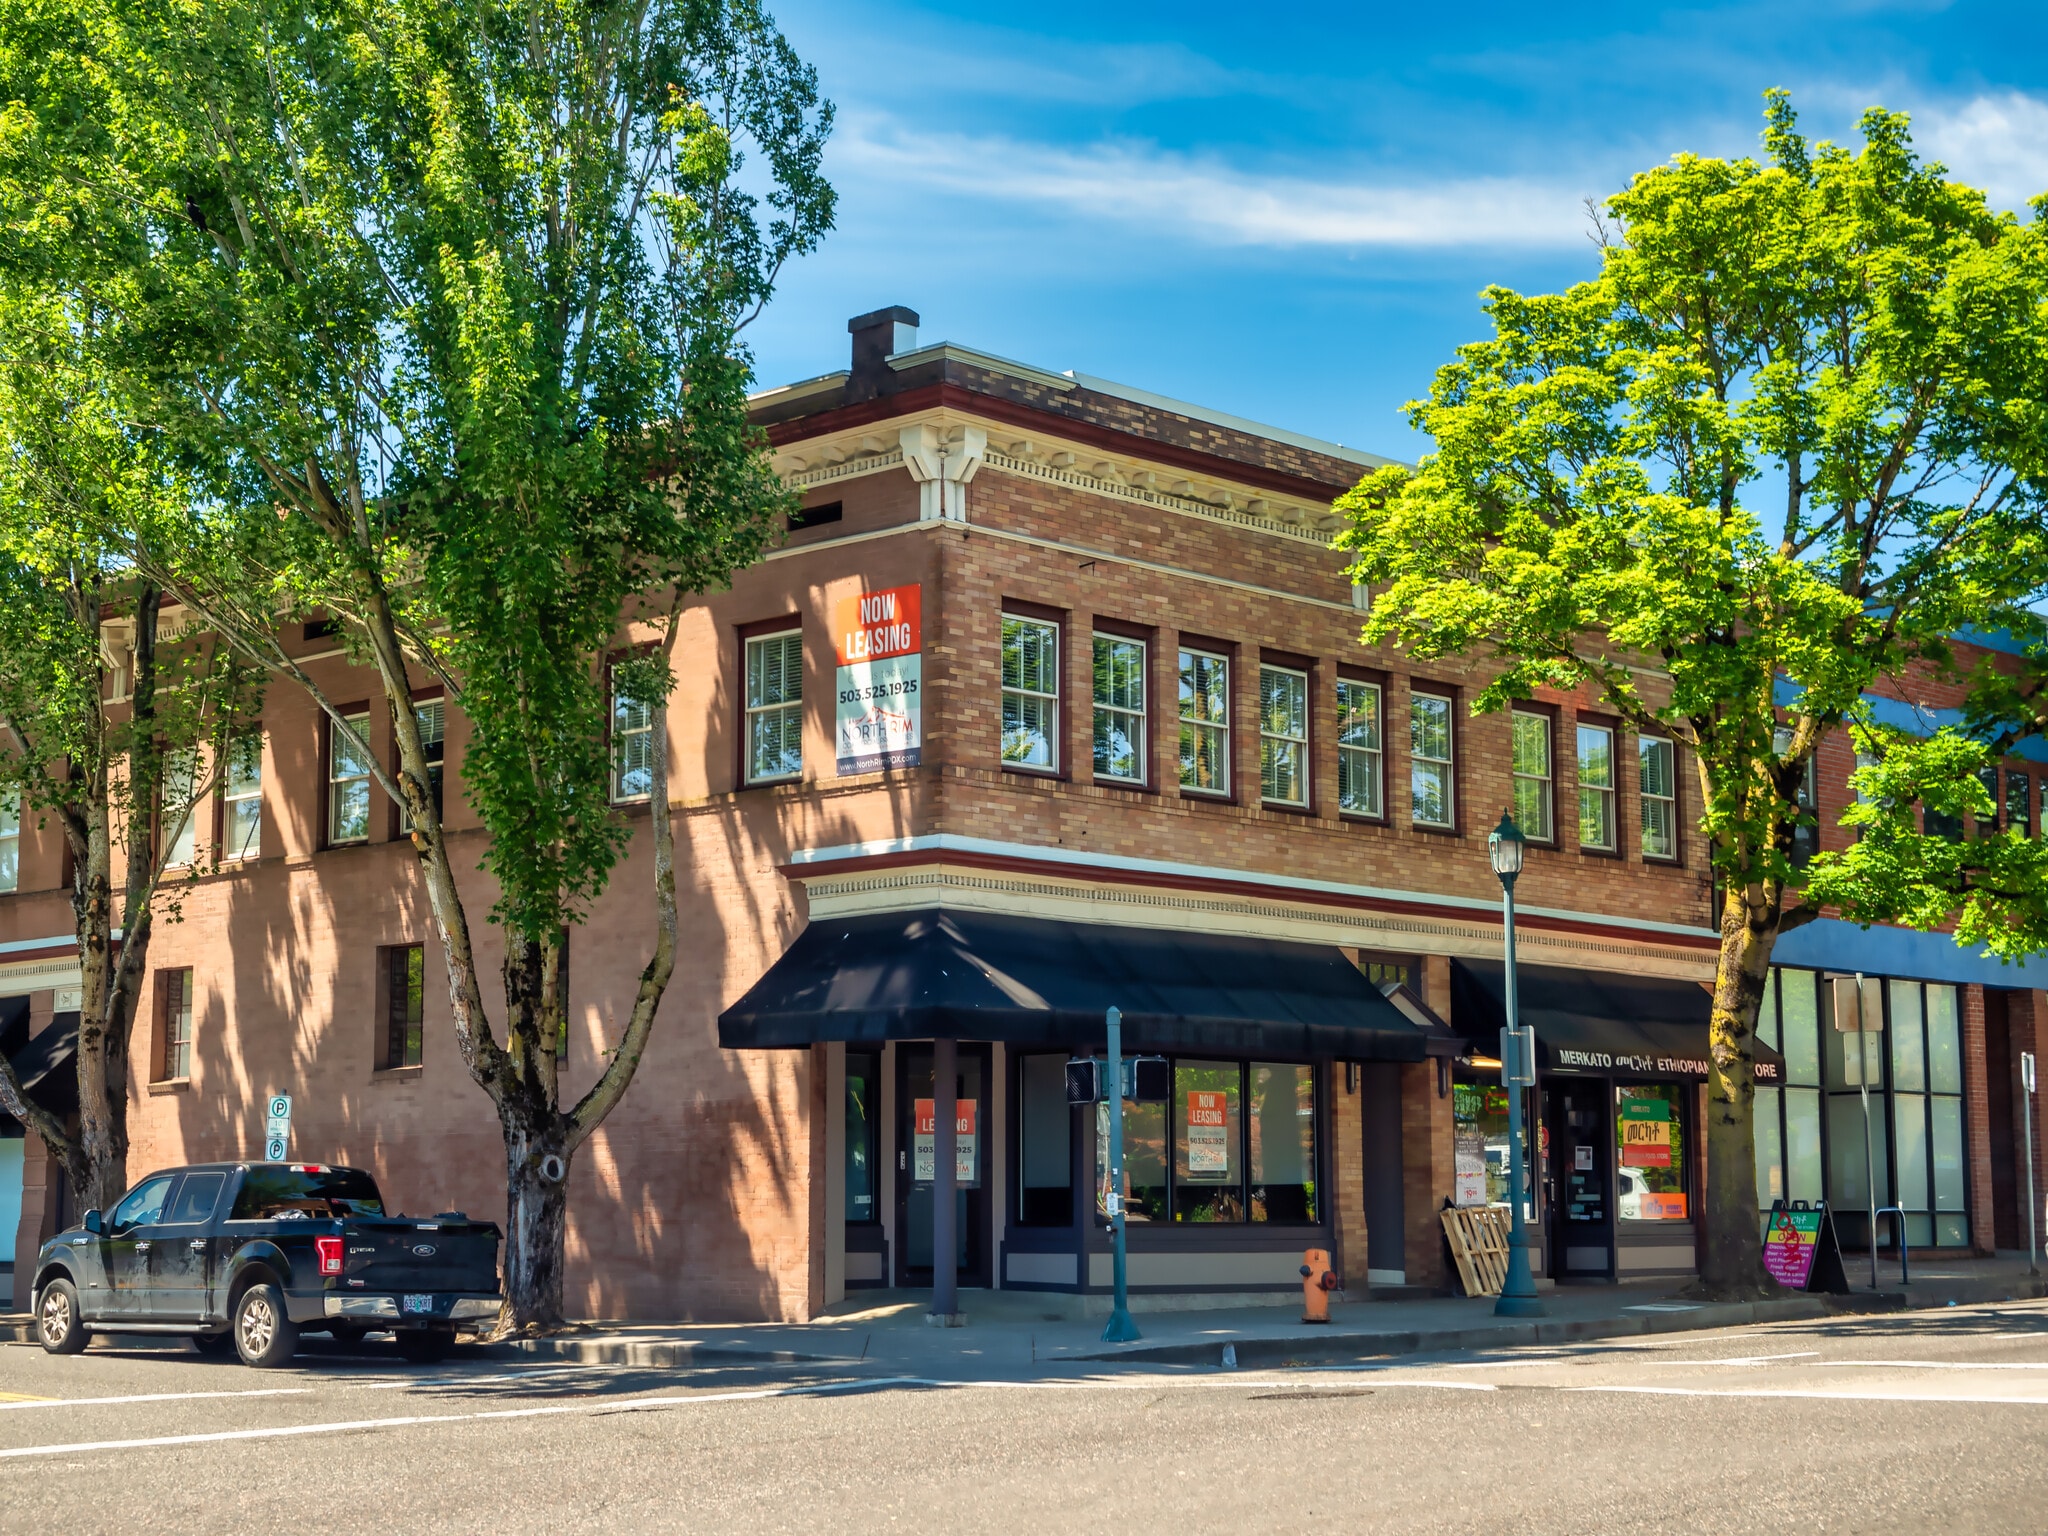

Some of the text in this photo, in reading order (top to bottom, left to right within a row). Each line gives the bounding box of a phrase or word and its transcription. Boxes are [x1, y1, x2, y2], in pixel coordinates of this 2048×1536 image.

[861, 593, 896, 625] NOW
[846, 622, 911, 660] LEASING
[839, 679, 918, 704] 503.525.1925
[842, 721, 887, 743] NORTH
[890, 717, 914, 734] RIM
[1559, 1049, 1612, 1068] MERKATO
[1755, 1063, 1777, 1078] ORE
[1199, 1094, 1215, 1108] NOW
[1192, 1110, 1222, 1123] LEASING
